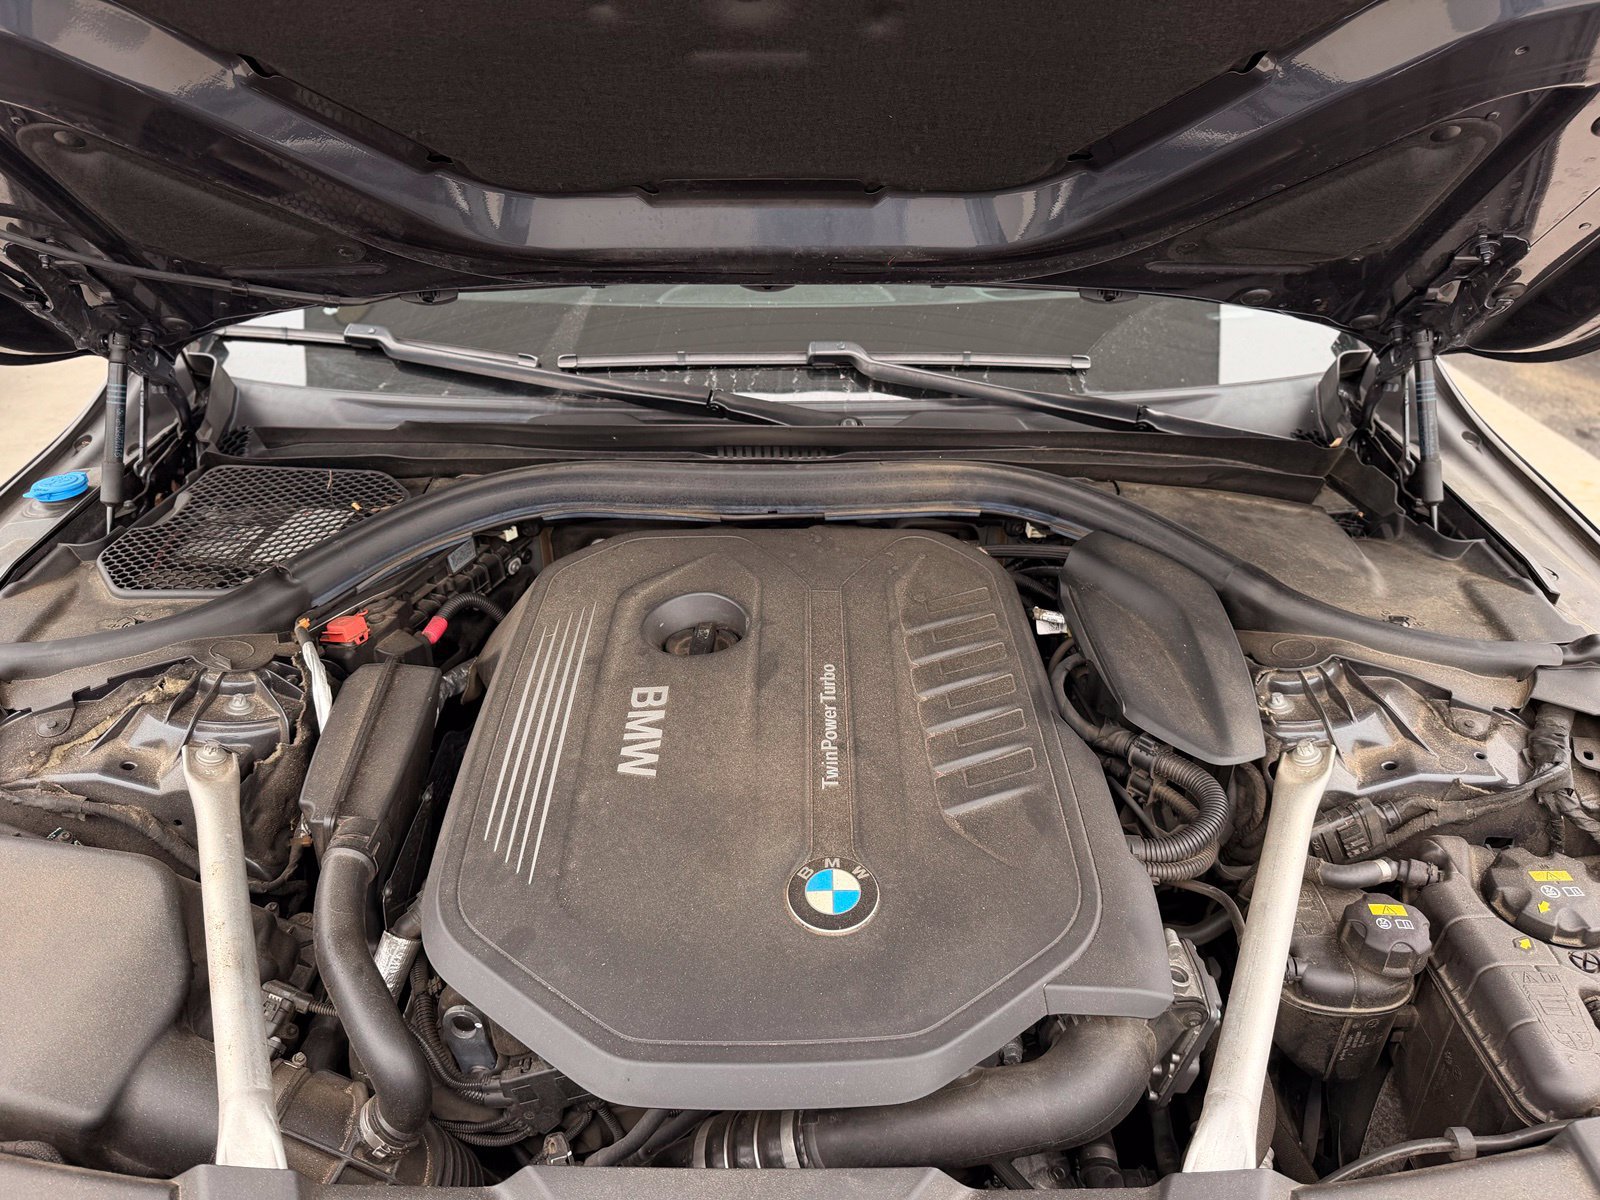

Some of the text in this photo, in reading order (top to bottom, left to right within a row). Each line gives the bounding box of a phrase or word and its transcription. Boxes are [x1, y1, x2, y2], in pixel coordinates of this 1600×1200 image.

[617, 686, 669, 776] BMW
[820, 664, 839, 789] TwinPower Turbo
[797, 858, 870, 880] BMW
